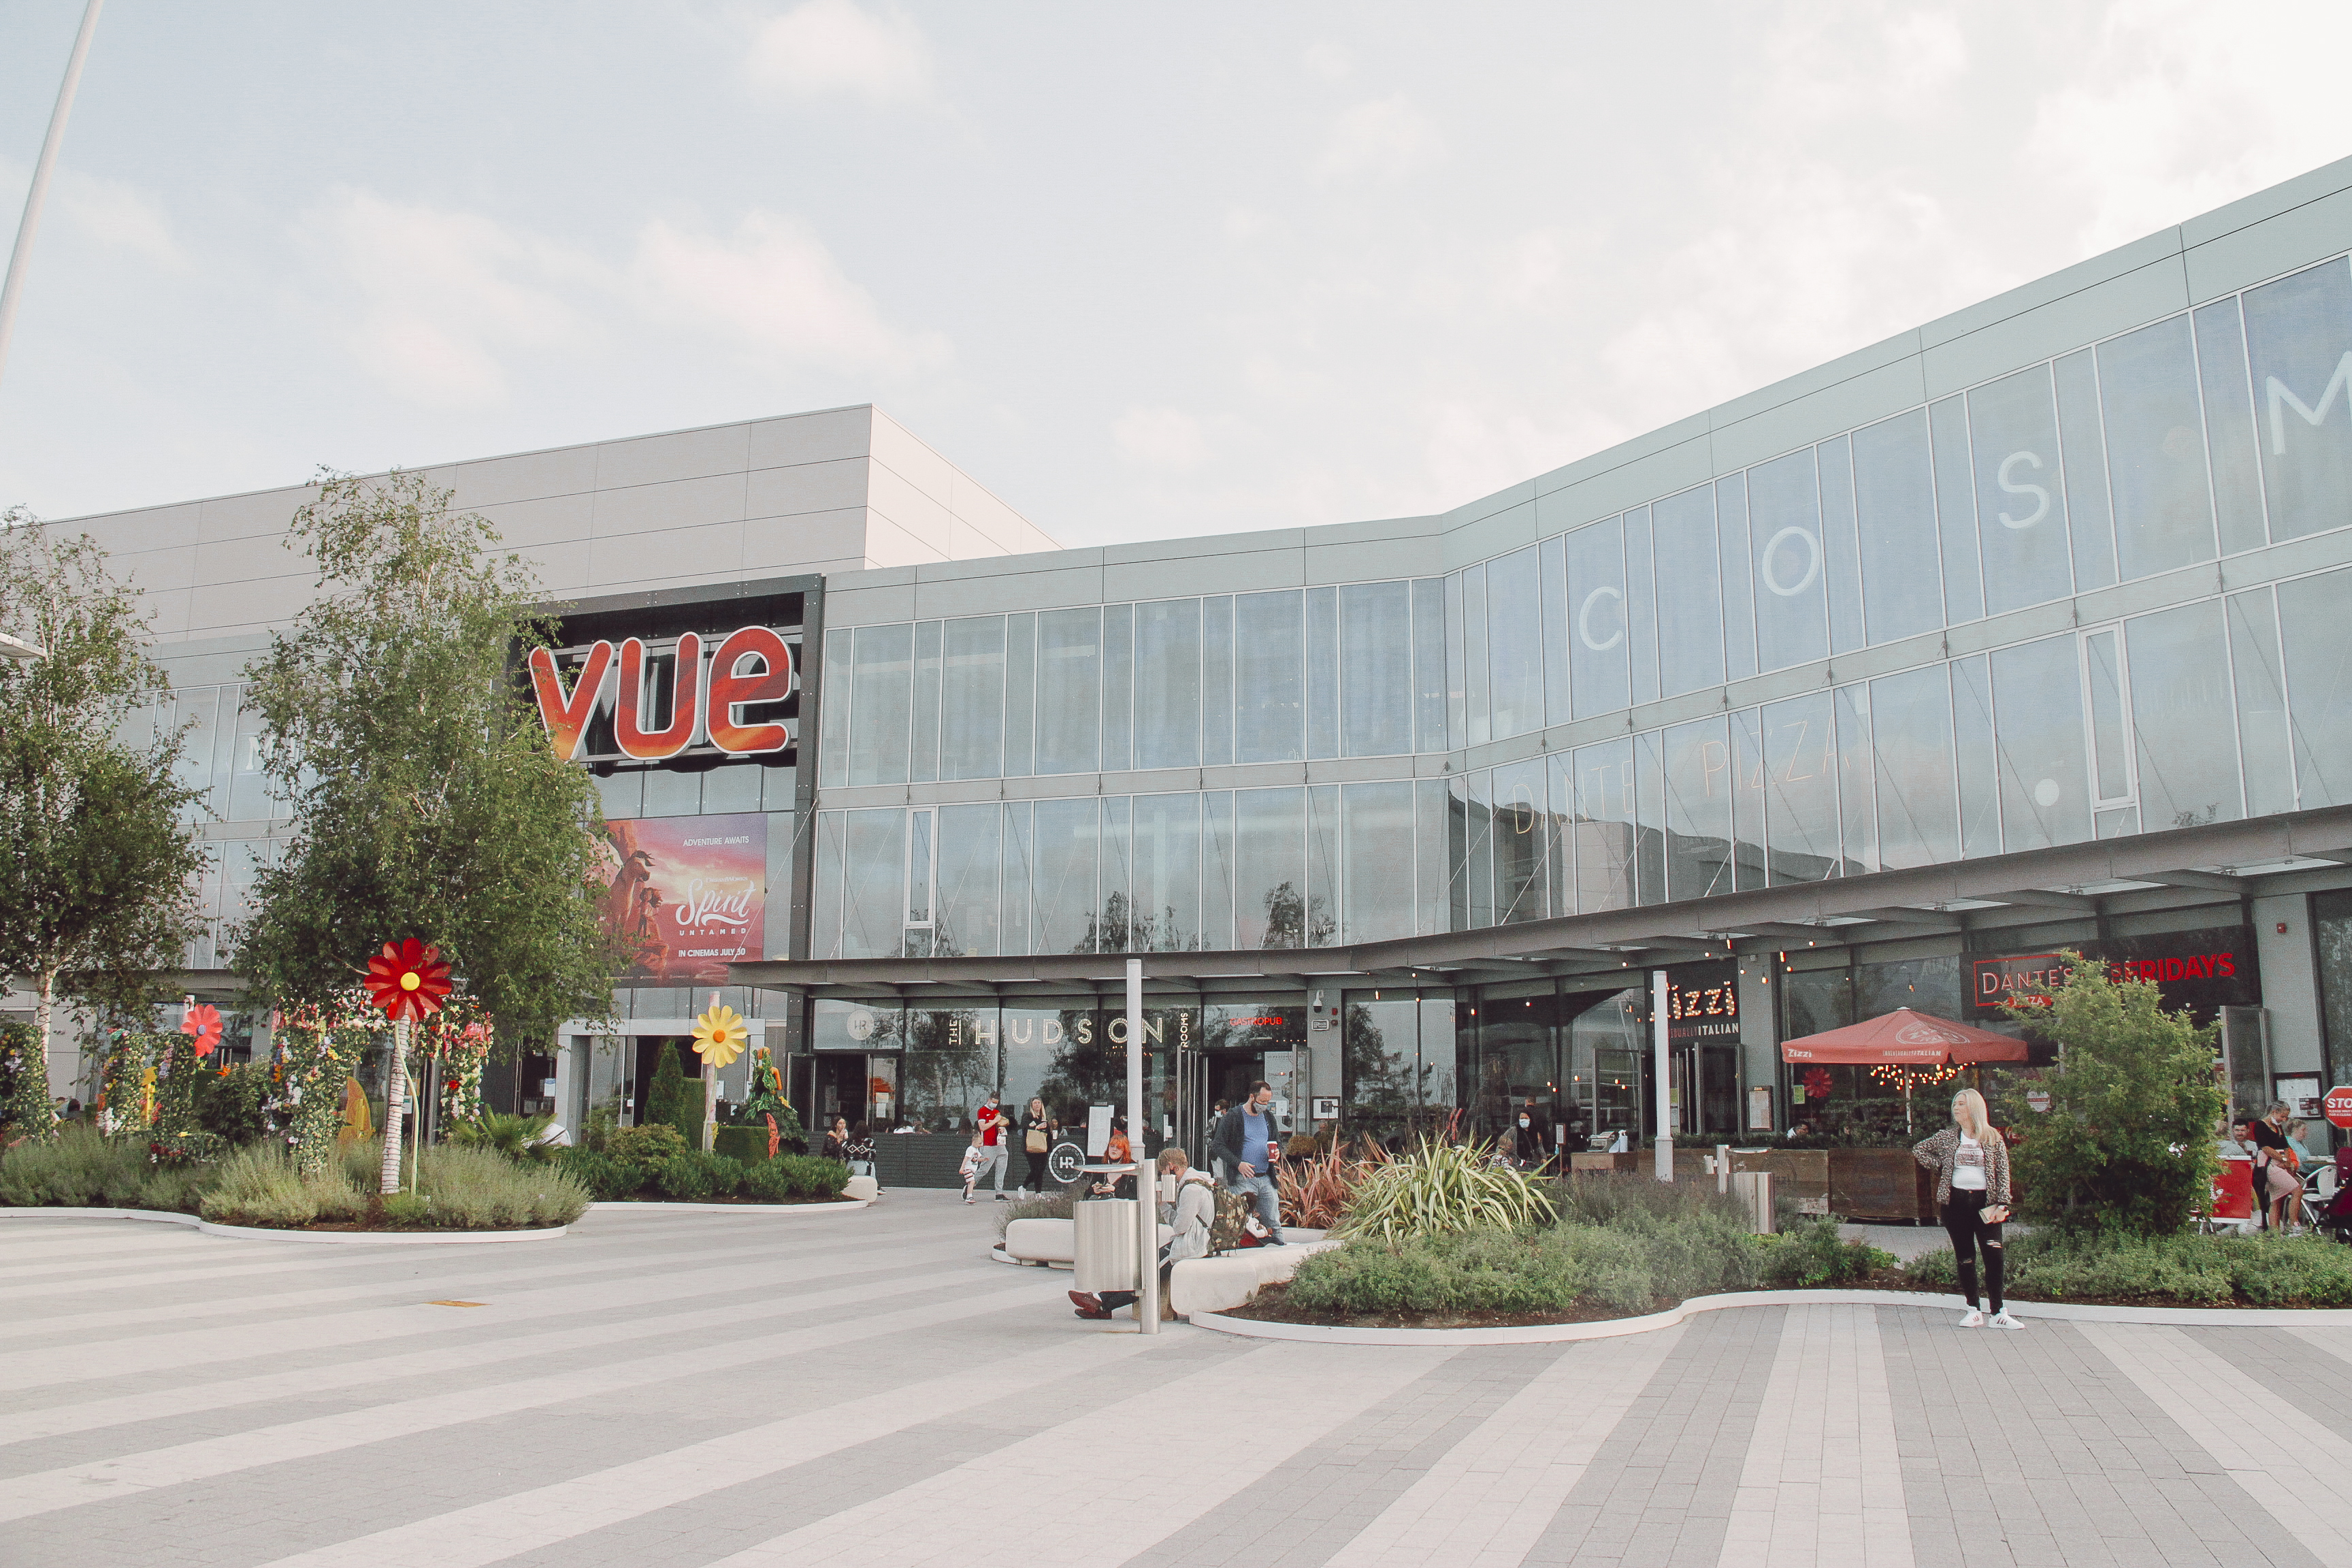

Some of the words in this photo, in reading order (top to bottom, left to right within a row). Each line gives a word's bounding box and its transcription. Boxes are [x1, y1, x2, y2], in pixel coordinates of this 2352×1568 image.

[683, 837, 723, 847] ADVENTURE
[724, 835, 749, 845] AWAITS
[675, 878, 757, 927] Spirit
[679, 928, 747, 936] UNTAMED
[687, 949, 719, 958] CINEMAS
[720, 949, 735, 957] JULY
[736, 947, 746, 956] 30
[2124, 953, 2236, 983] FRIDAYS
[1230, 1017, 1283, 1026] GASTROPUB
[949, 1019, 958, 1045] THE
[975, 1017, 1163, 1045] HUDSON
[1180, 1012, 1188, 1048] ROOMS
[1698, 1023, 1739, 1036] ITALIAN
[1059, 1156, 1075, 1169] HR
